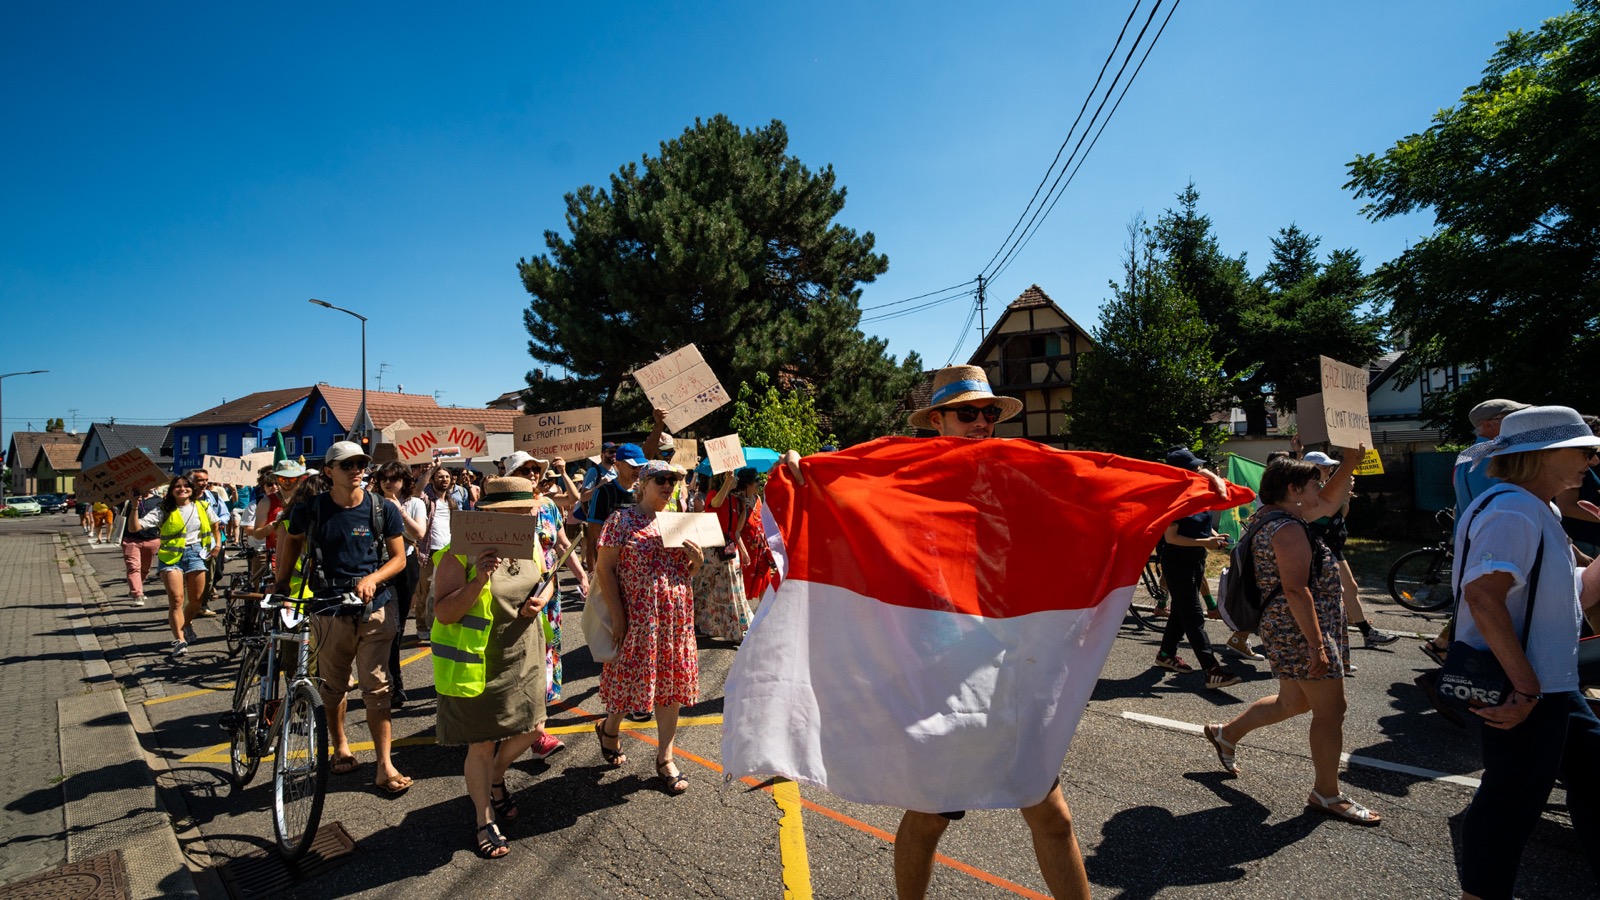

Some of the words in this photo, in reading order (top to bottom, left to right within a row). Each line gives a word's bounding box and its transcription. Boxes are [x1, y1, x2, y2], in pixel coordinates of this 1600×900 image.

[646, 369, 666, 387] NON
[1322, 363, 1340, 390] GAZ
[538, 414, 565, 427] GNL
[522, 433, 532, 442] LE
[563, 426, 577, 435] POUR
[577, 423, 592, 433] EUX
[398, 430, 438, 460] NON
[447, 426, 486, 453] NON
[560, 443, 573, 452] POUR
[707, 439, 727, 453] NON
[107, 452, 141, 471] GNL
[208, 456, 252, 472] NON
[680, 453, 696, 463] NON
[722, 454, 740, 469] NON
[456, 514, 493, 525] TEPSA
[464, 529, 486, 542] NON
[512, 531, 533, 542] NON
[1442, 677, 1473, 685] CORSICA
